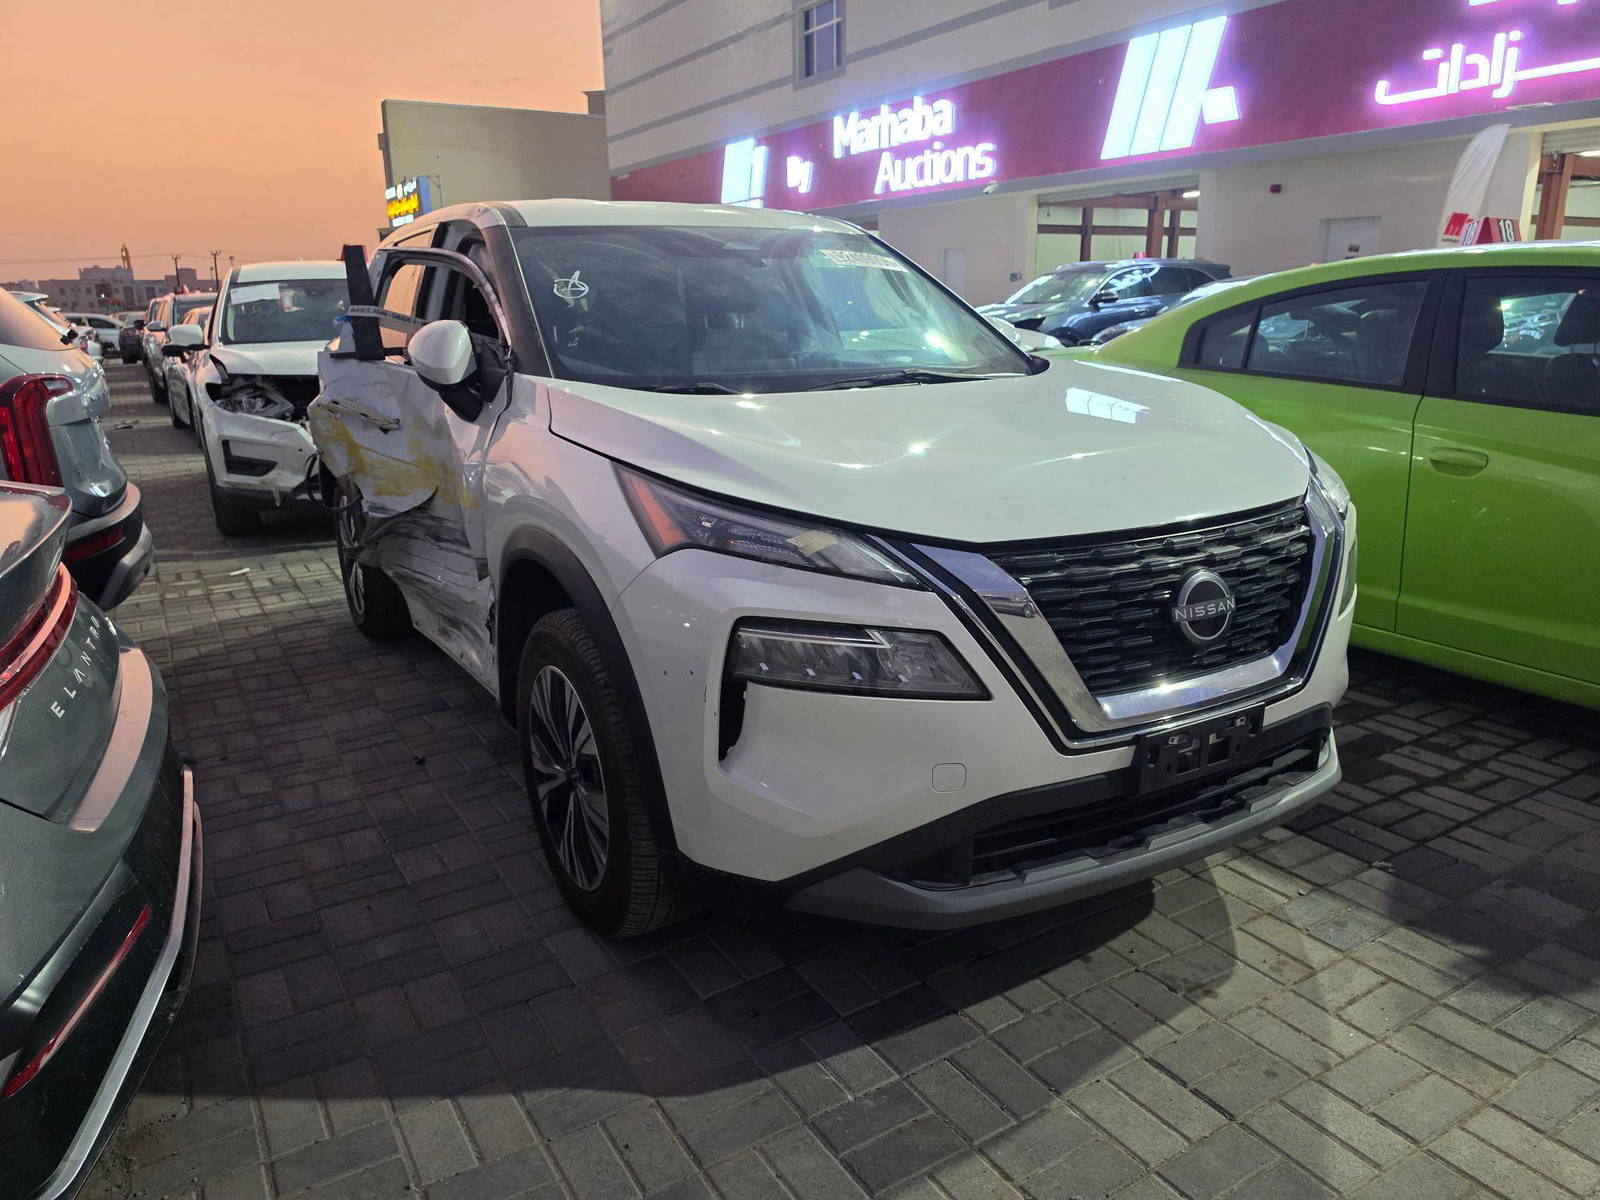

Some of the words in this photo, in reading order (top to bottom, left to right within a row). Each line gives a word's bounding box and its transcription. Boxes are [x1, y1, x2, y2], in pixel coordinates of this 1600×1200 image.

[1374, 30, 1600, 105] زادات
[833, 95, 956, 159] Marhaba
[873, 141, 997, 194] Auctions
[1499, 219, 1516, 243] 18
[1174, 598, 1235, 620] NISSAN
[50, 615, 101, 719] ELANTRA
